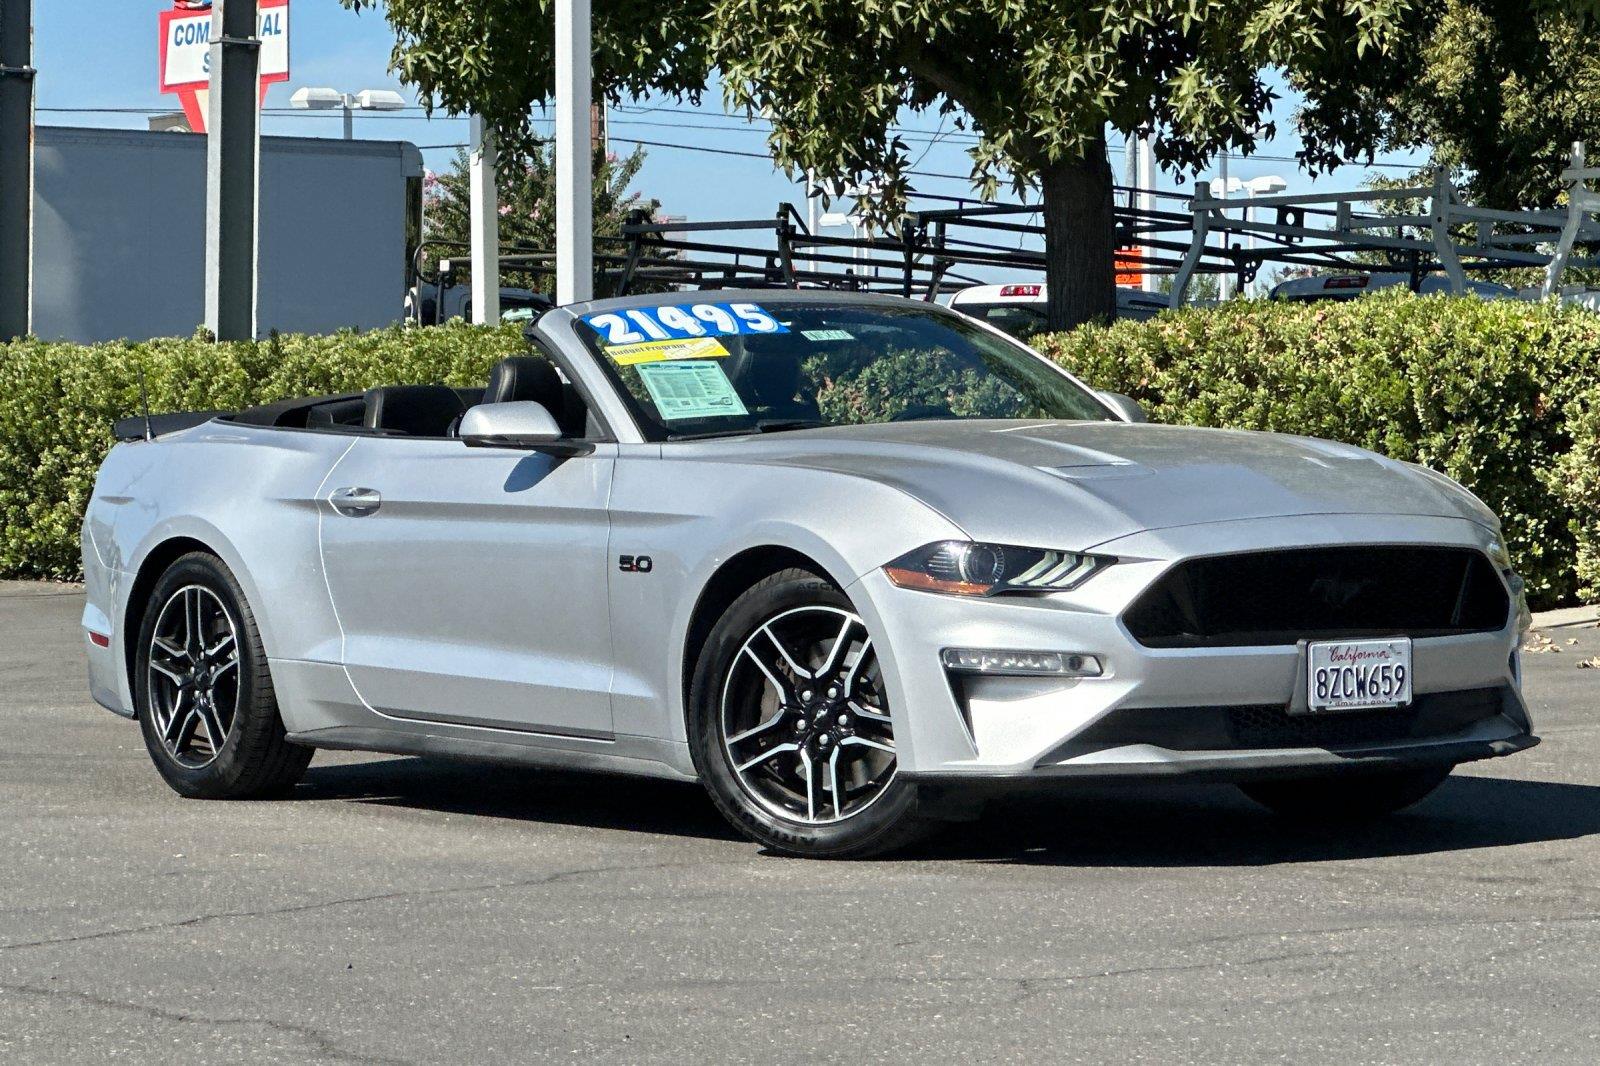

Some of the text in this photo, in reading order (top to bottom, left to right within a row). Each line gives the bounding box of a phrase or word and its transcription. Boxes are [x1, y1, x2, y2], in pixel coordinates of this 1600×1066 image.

[174, 13, 281, 46] COMAL
[589, 303, 778, 343] 21495
[646, 343, 687, 352] Program
[619, 554, 653, 573] 5.0
[1330, 645, 1390, 664] California
[1316, 665, 1405, 699] 8ZCW659
